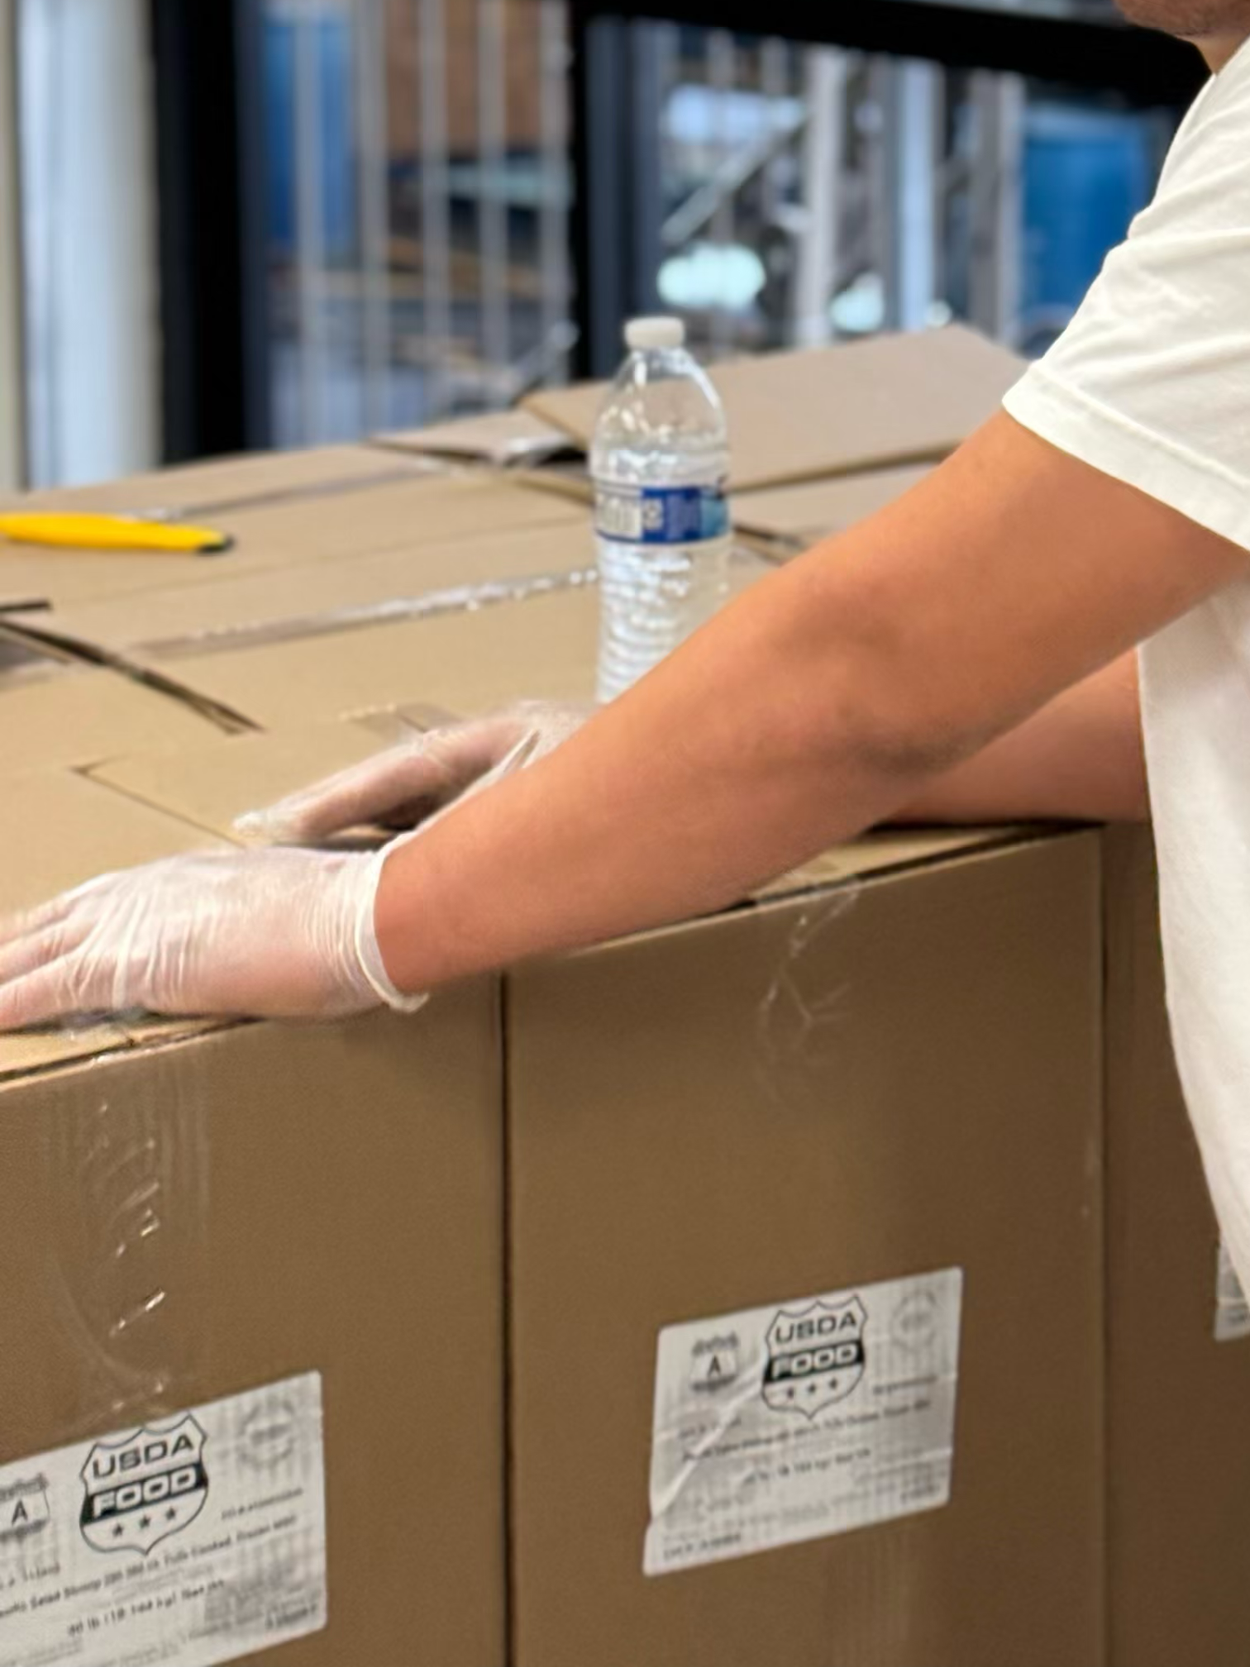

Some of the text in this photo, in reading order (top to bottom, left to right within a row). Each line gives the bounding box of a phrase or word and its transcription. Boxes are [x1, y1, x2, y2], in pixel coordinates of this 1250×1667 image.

[775, 1311, 858, 1345] USDA
[772, 1343, 859, 1380] FOOD
[93, 1434, 194, 1479] USDA
[94, 1466, 197, 1519] FOOD
[11, 1499, 28, 1527] A
